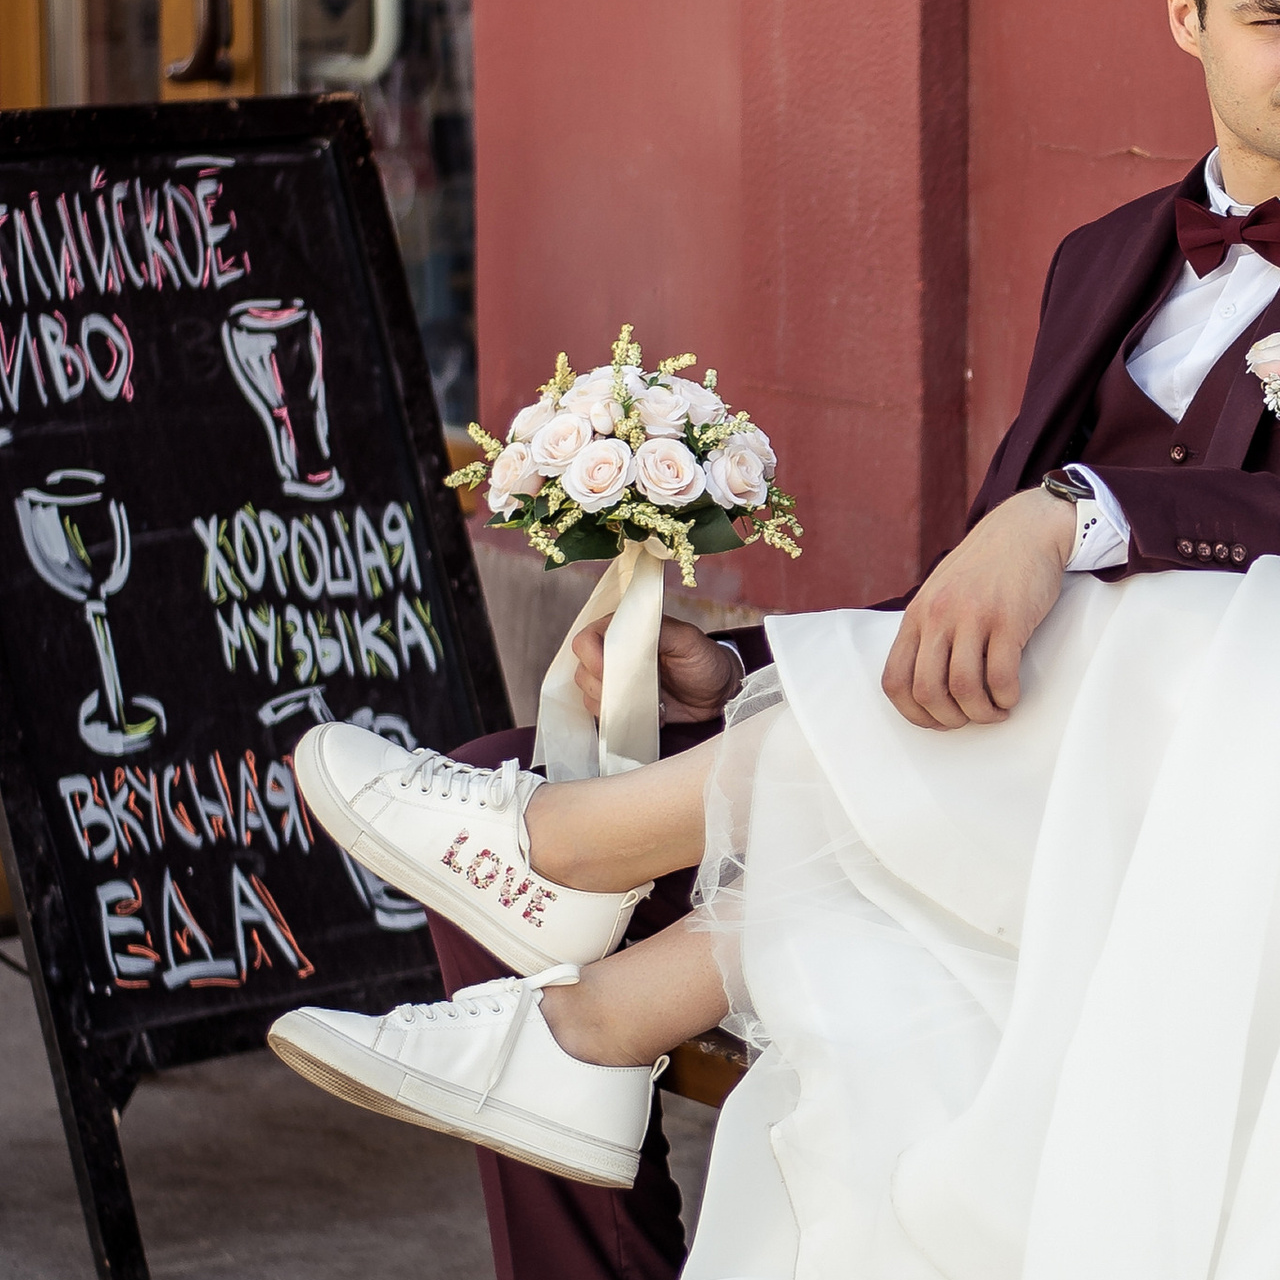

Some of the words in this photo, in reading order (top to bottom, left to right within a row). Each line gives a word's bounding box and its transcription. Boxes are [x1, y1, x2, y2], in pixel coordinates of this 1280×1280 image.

[0, 164, 250, 307] ЛИЙСКОЕ
[0, 311, 134, 413] ИВО
[194, 501, 422, 603] ХОРОШАЯ
[215, 593, 443, 685] МУЗЫКА
[58, 751, 314, 865] ВКУСНАЯ
[97, 864, 313, 989] ЕДА
[440, 828, 558, 927] LOVE
